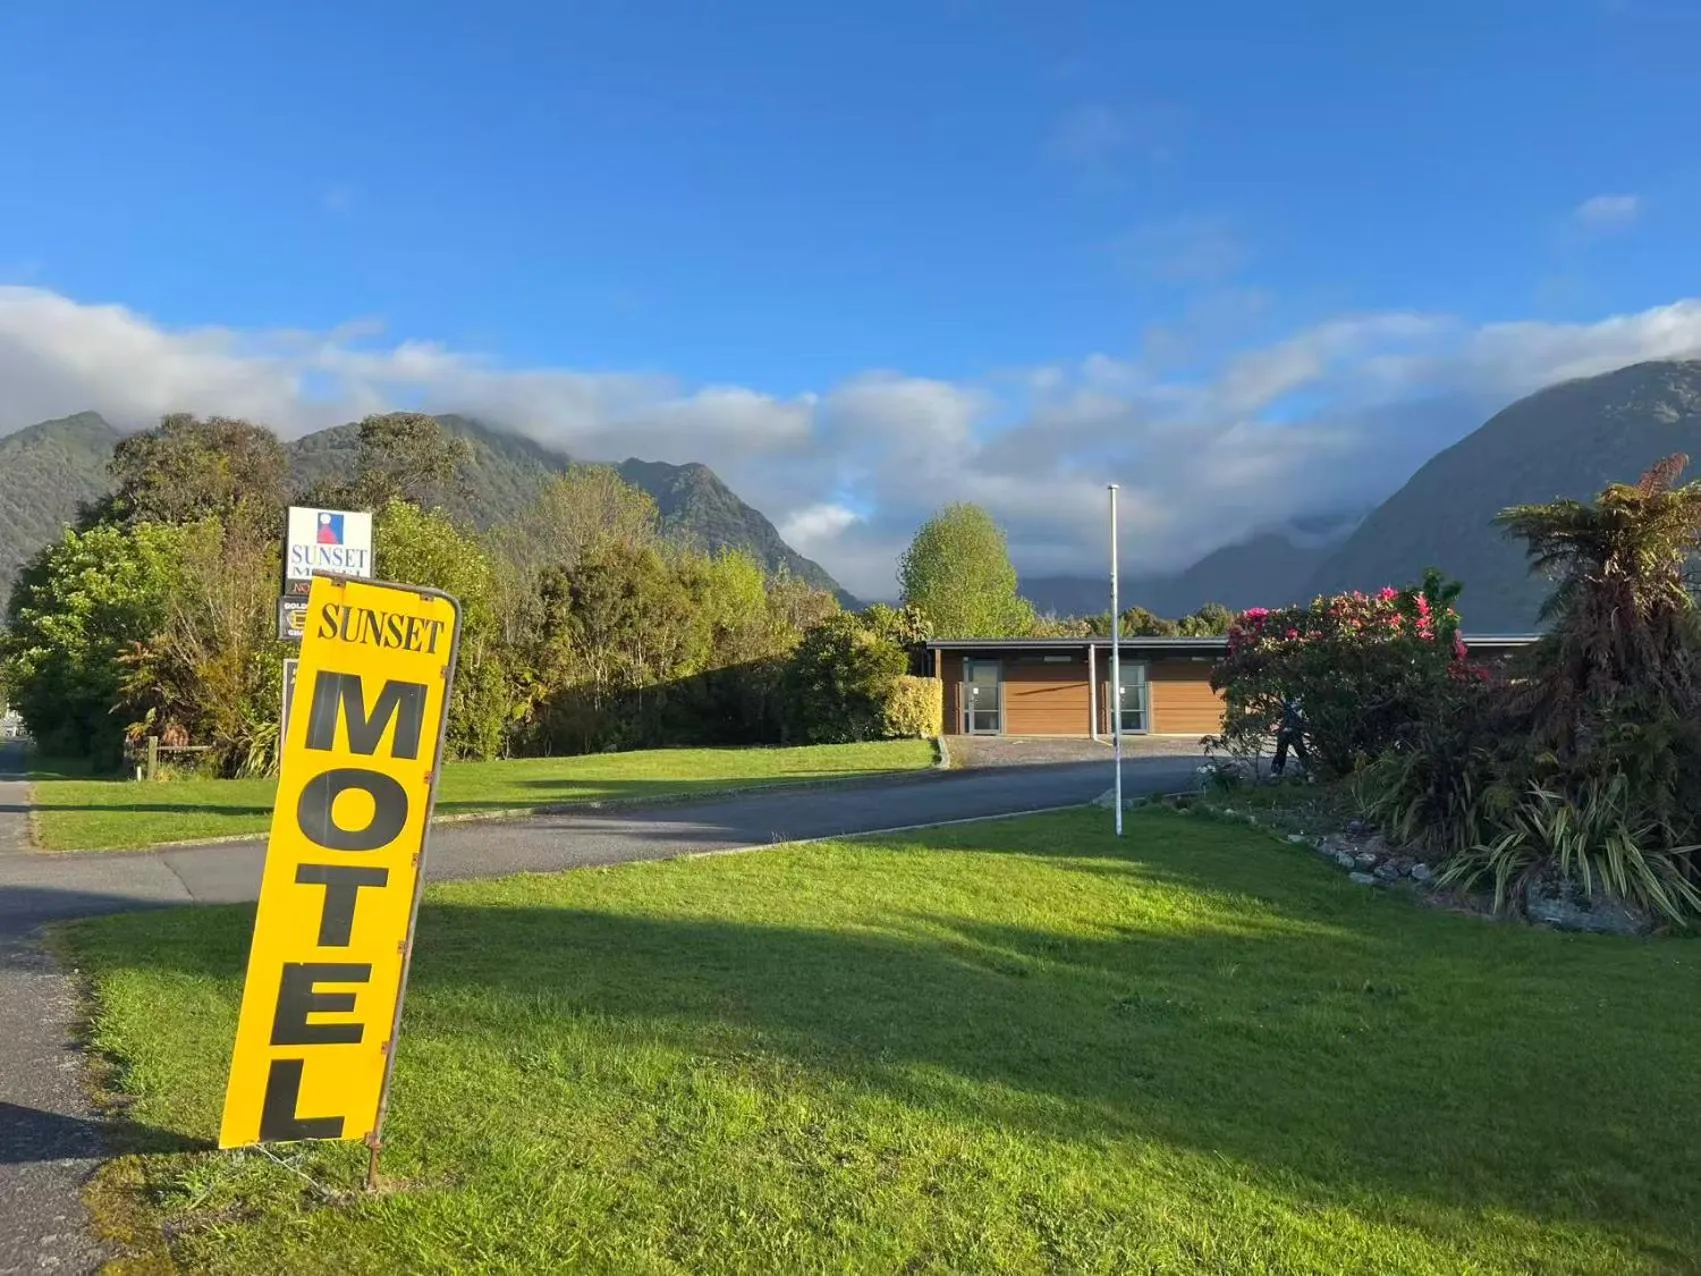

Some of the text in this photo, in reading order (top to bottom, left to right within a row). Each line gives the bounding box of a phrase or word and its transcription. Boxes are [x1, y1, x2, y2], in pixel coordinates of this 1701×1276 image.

[292, 544, 368, 568] SUNSET
[317, 602, 445, 654] SUNSET
[259, 670, 428, 1143] MOTEL
